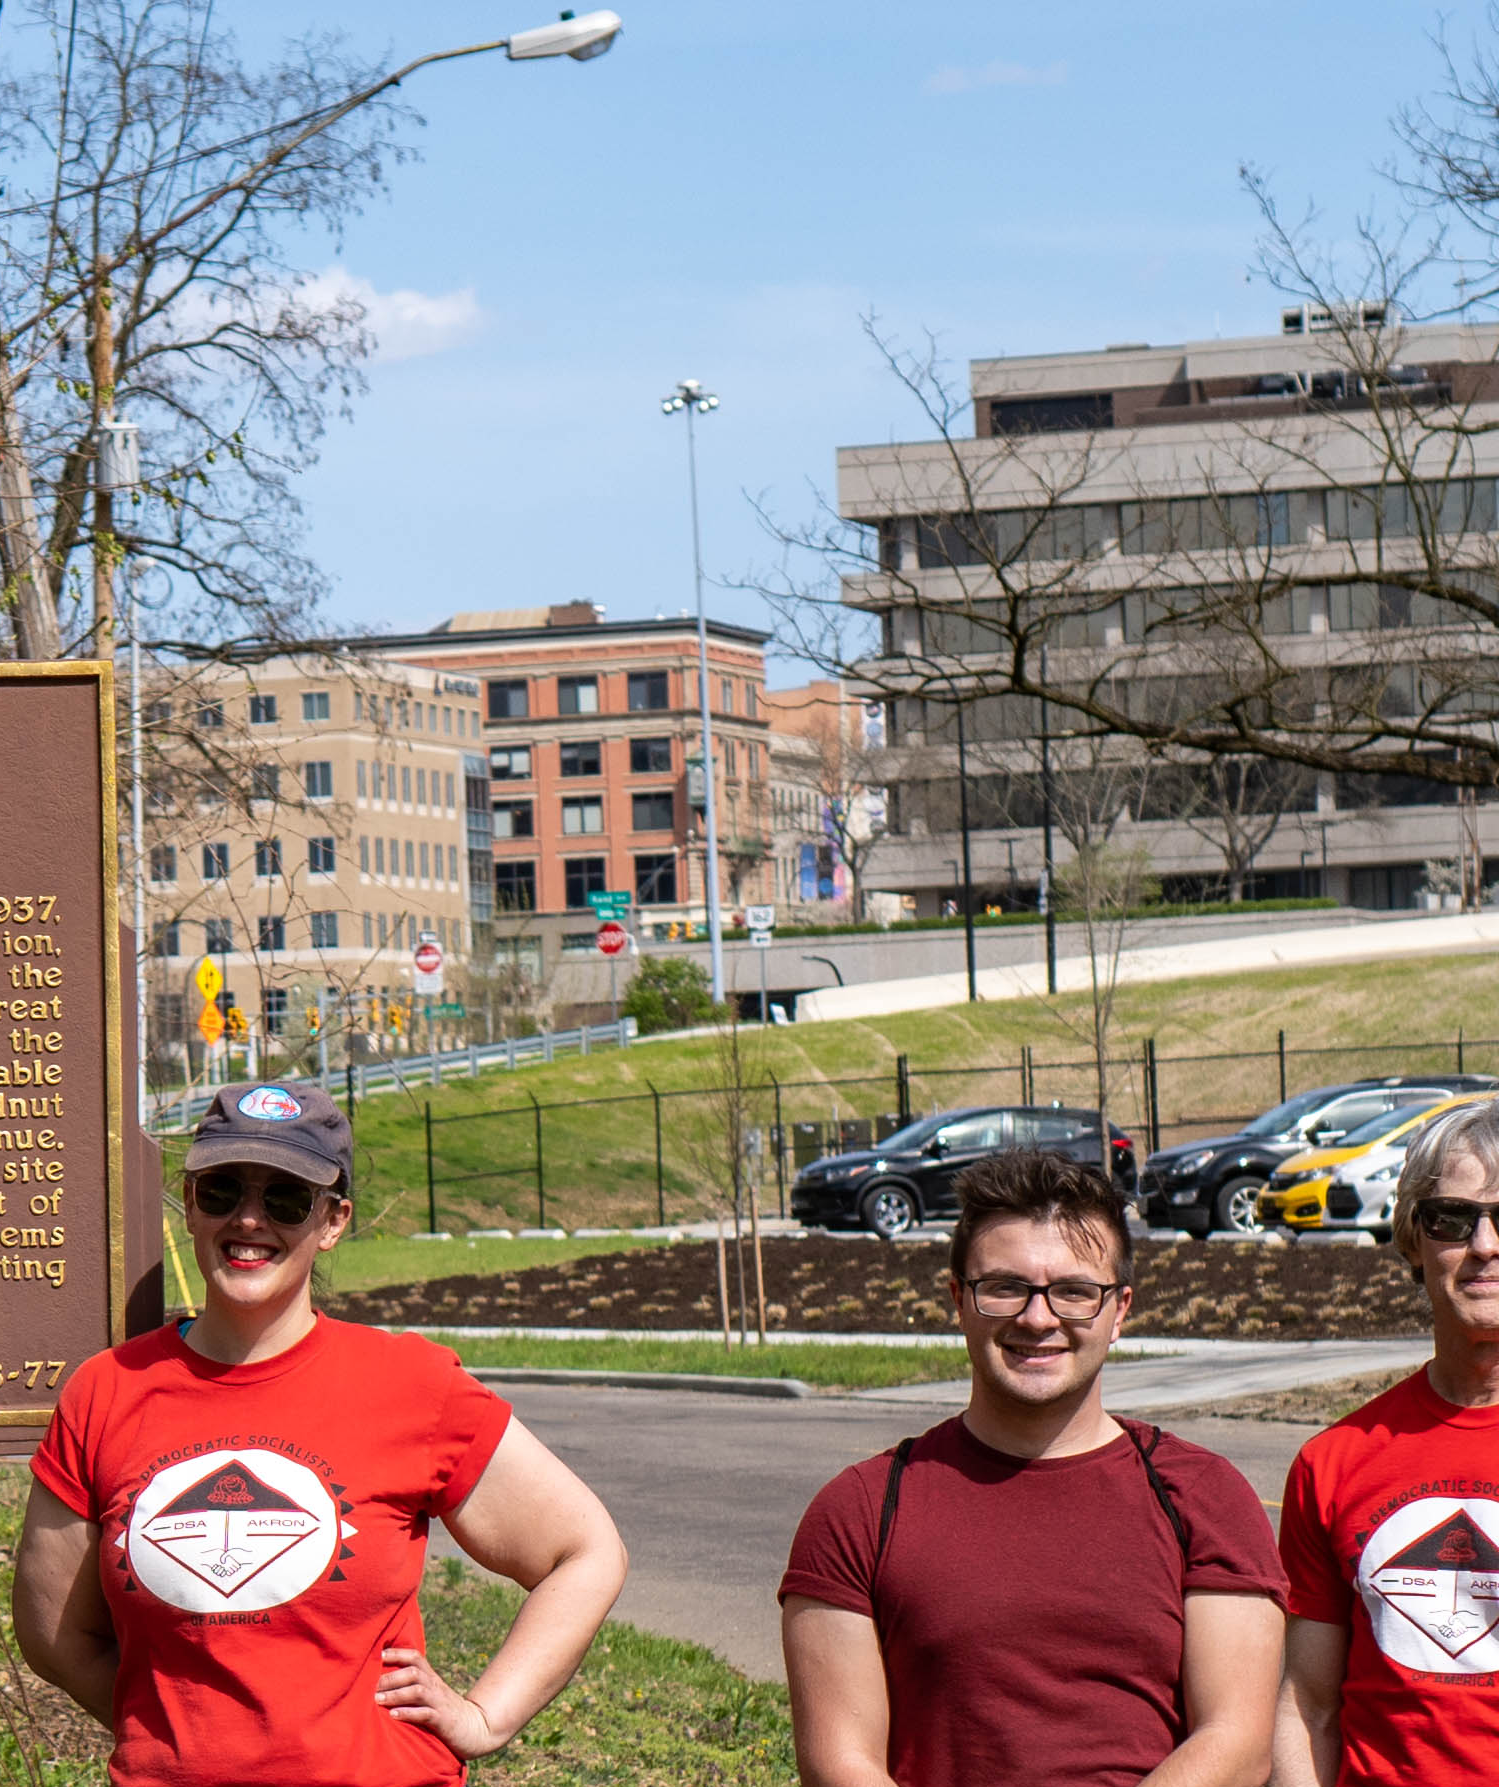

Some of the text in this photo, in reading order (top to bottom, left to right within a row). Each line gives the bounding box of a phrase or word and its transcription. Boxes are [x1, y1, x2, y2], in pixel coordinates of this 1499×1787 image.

[598, 931, 625, 946] STOP
[11, 962, 63, 988] the
[11, 1027, 64, 1053] the
[3, 1160, 64, 1182] site
[30, 1188, 64, 1215] of
[139, 1435, 334, 1482] DEMOCRATIC SOCIALISTS
[1369, 1479, 1468, 1526] DEMOCRATIC
[173, 1518, 305, 1530] DSA AKRON
[1402, 1577, 1437, 1587] DSA
[190, 1612, 271, 1626] OF AMERICA
[1432, 1674, 1496, 1688] AMERICA
